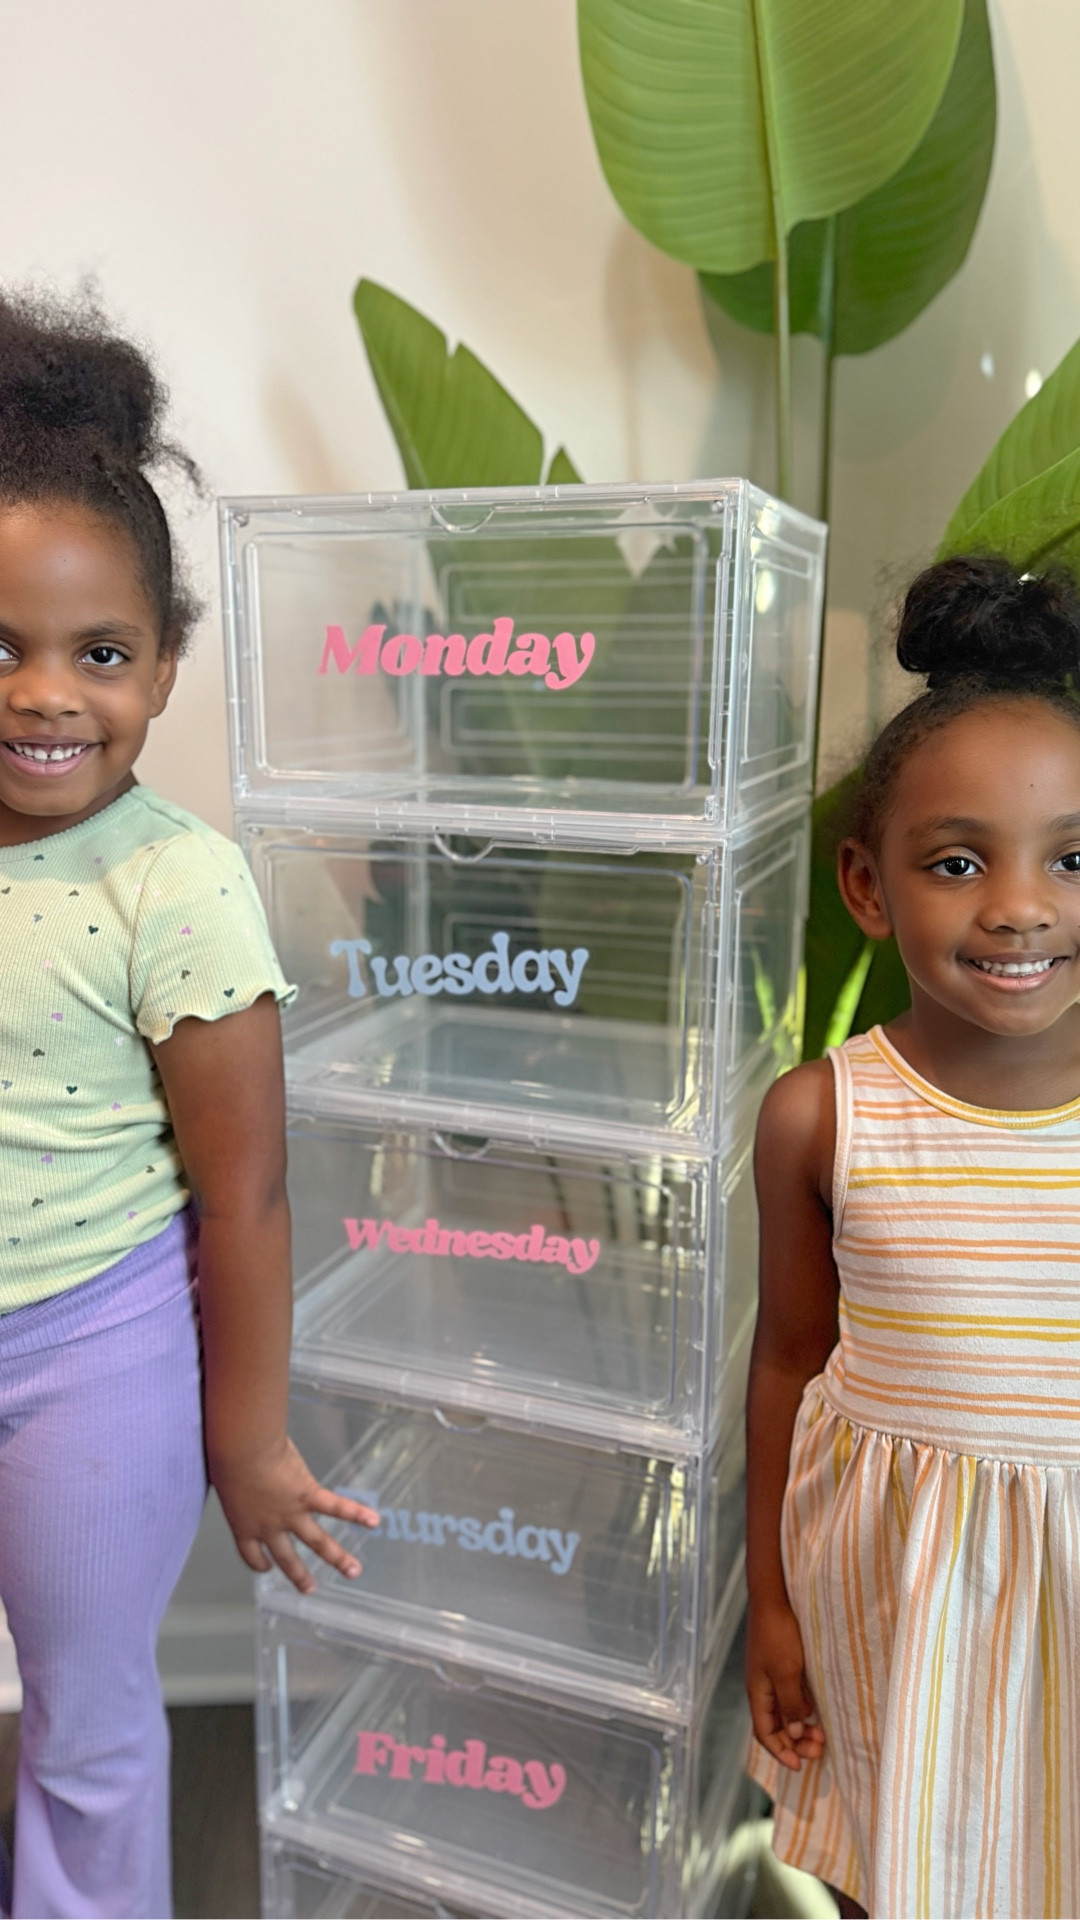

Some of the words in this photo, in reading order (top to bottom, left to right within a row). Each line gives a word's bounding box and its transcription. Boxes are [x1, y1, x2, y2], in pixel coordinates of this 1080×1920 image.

[318, 616, 596, 690] Monday
[330, 931, 589, 1006] Tuesday
[343, 1218, 600, 1273] Wednesday
[355, 1731, 566, 1809] Friday
